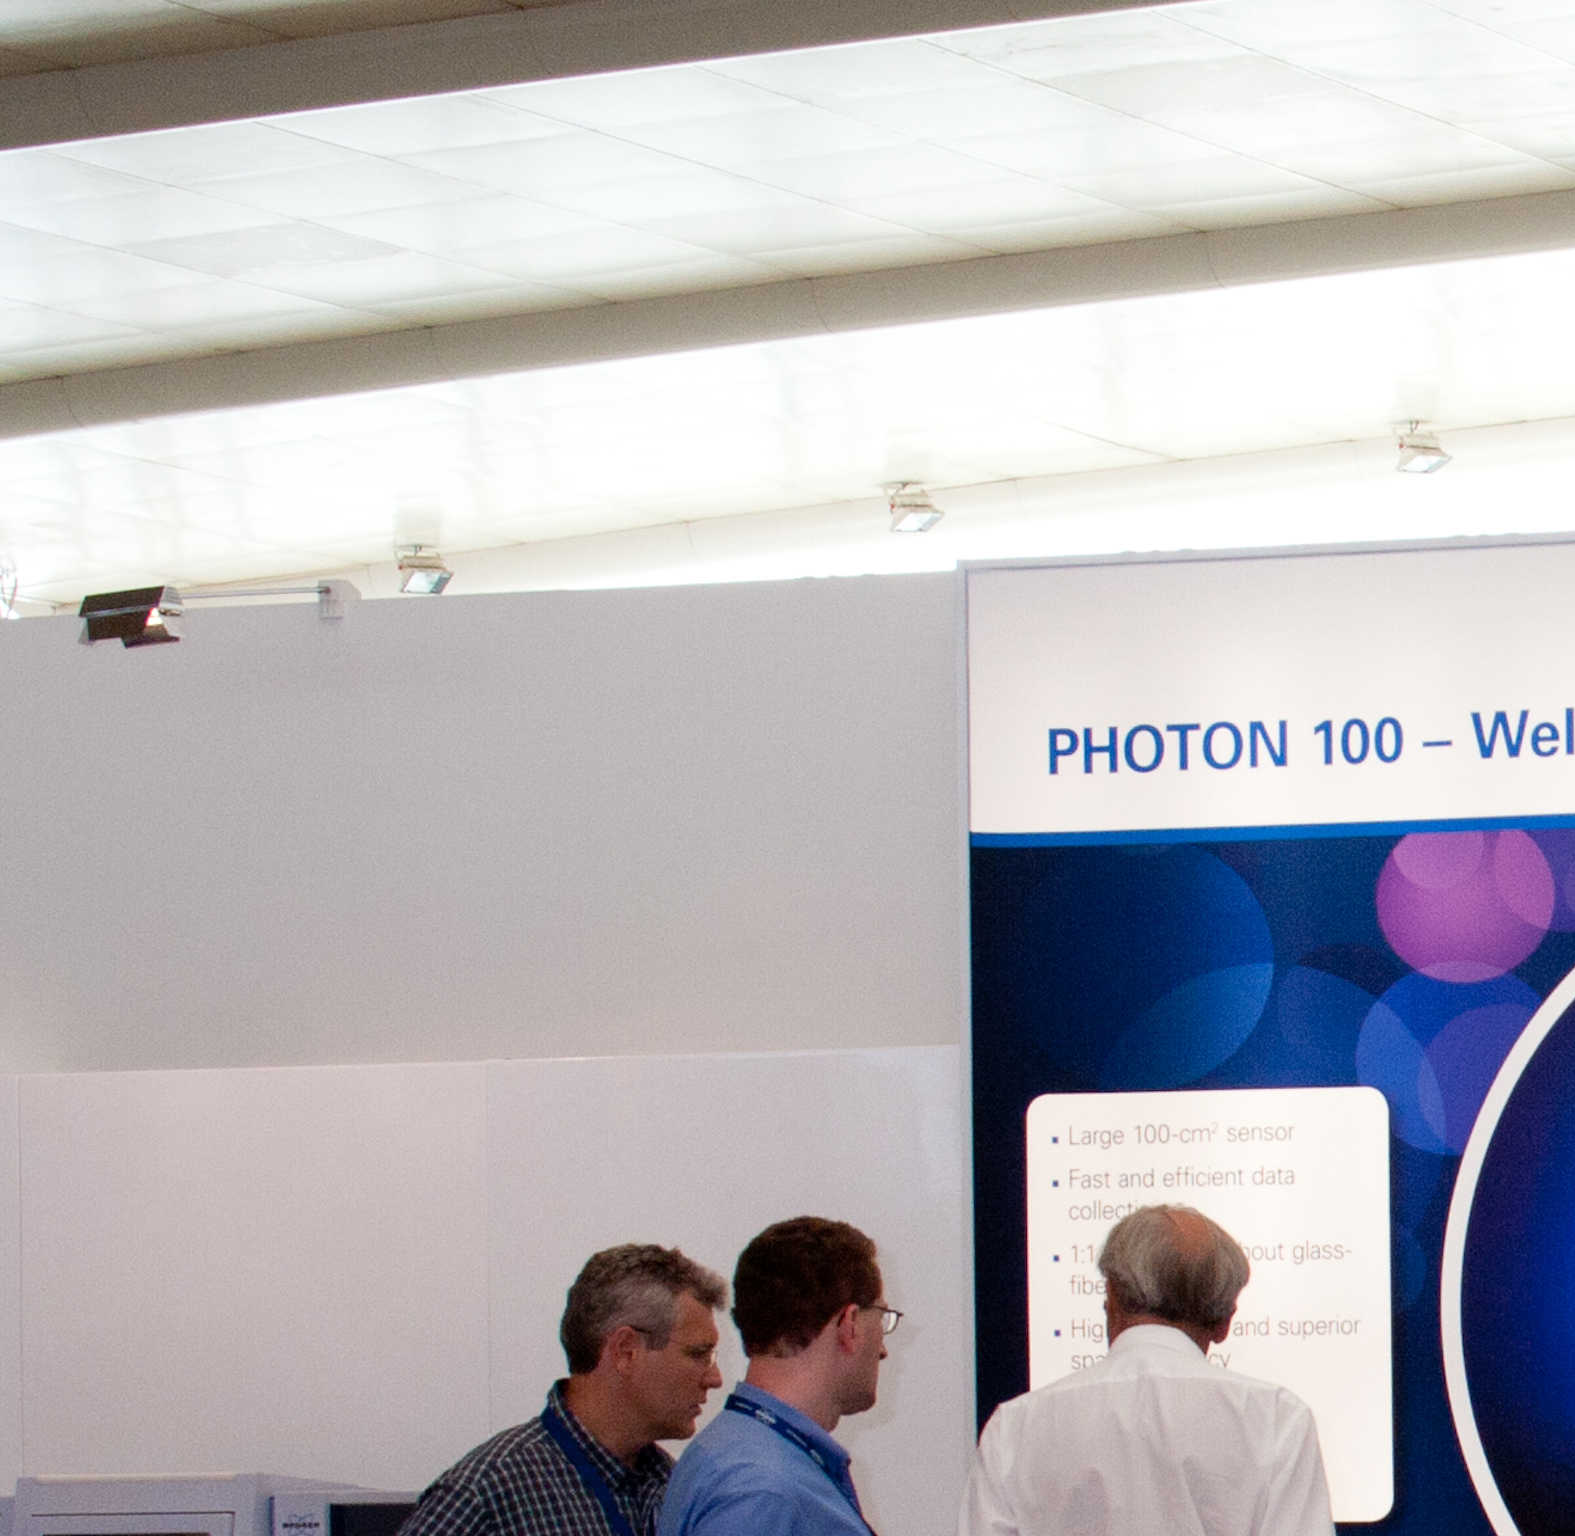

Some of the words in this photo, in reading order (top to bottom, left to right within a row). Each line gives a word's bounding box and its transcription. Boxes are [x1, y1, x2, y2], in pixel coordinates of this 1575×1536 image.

[1048, 719, 1288, 776] PHOTON
[1313, 716, 1404, 766] 100
[1068, 1124, 1125, 1150] Large
[1227, 1125, 1296, 1143] sensor
[1068, 1168, 1111, 1190] Fast
[1118, 1167, 1155, 1189] and
[1162, 1166, 1244, 1188] efficient
[1251, 1165, 1296, 1187] data
[1292, 1240, 1353, 1265] glass-
[1233, 1314, 1271, 1337] and
[1277, 1317, 1361, 1340] superior
